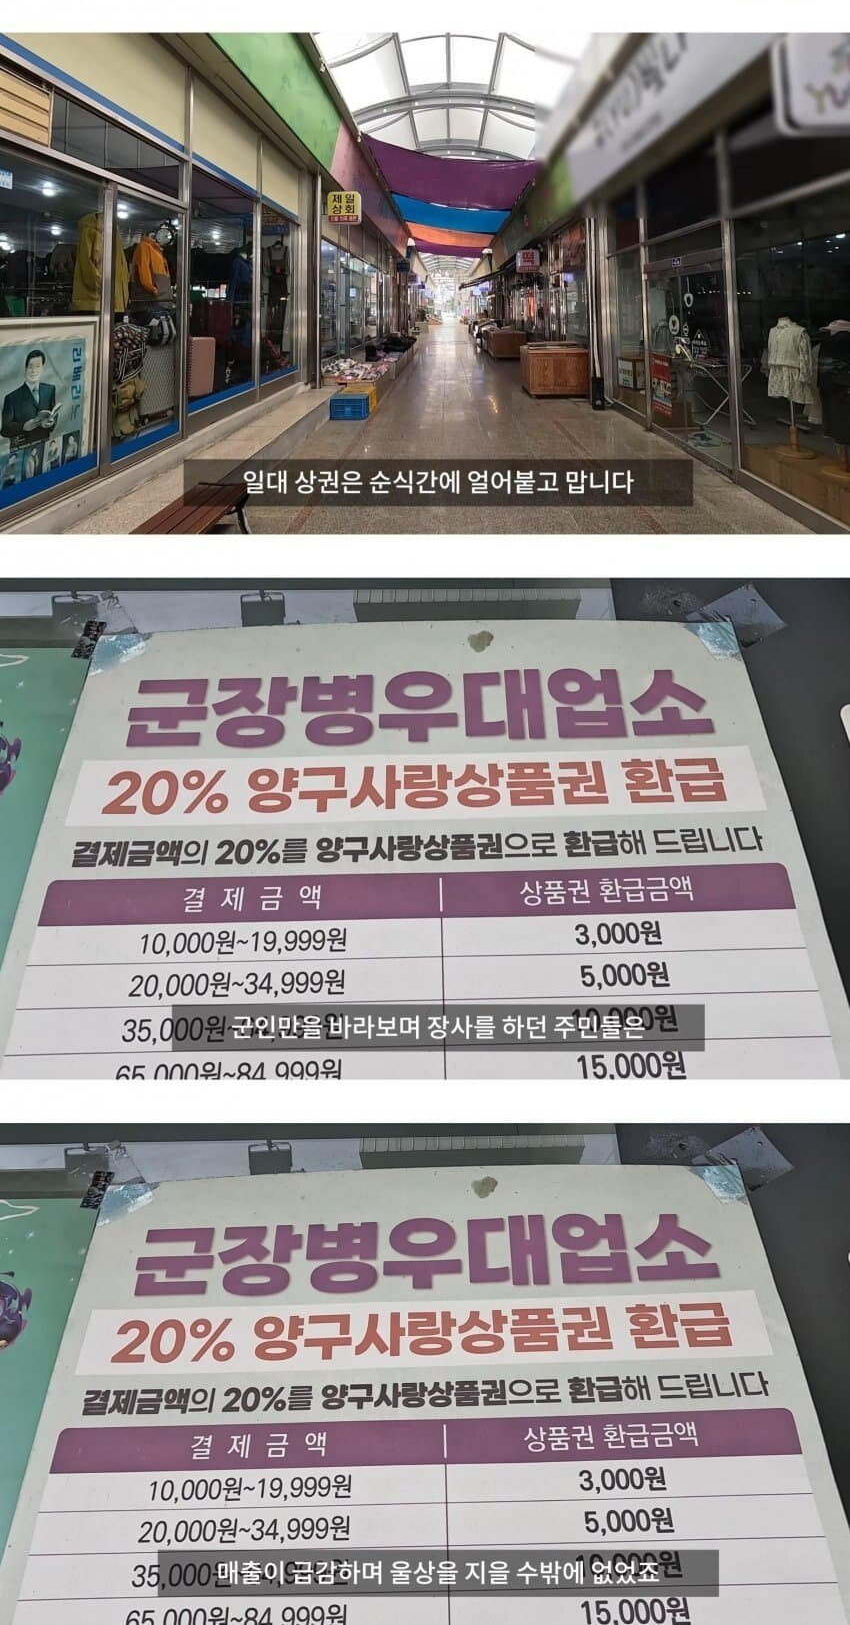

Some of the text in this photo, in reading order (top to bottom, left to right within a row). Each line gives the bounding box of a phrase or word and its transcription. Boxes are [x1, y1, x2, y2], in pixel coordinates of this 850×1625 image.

[331, 193, 355, 204] 제일
[331, 204, 355, 214] 상회
[126, 667, 717, 749] 군장병우대업소
[101, 757, 728, 816] 20% 양구사랑상품권 환급
[72, 826, 763, 867] 결제금액의 20%를 양구사랑상품권으로 환급해 드립니다
[520, 876, 693, 906] 상품권 환급금액
[141, 928, 346, 957] 10,000원~19,999원
[575, 921, 662, 948] 3,000원
[128, 970, 344, 1000] 20,000원~34,999원
[581, 962, 670, 990] 5,000원
[134, 1214, 720, 1296] 군장병우대업소
[110, 1303, 732, 1364] 20% 양구사랑상품권 환급
[82, 1371, 768, 1415] 결제금액의 20%를 양구사랑상품권으로 환급해 드립니다
[524, 1422, 698, 1452] 상품권 환급금액
[151, 1475, 351, 1503] 10,000원~19,999원
[579, 1467, 667, 1494] 3,000원
[138, 1516, 349, 1546] 20,000원~34,999원
[585, 1508, 674, 1536] 5,000원
